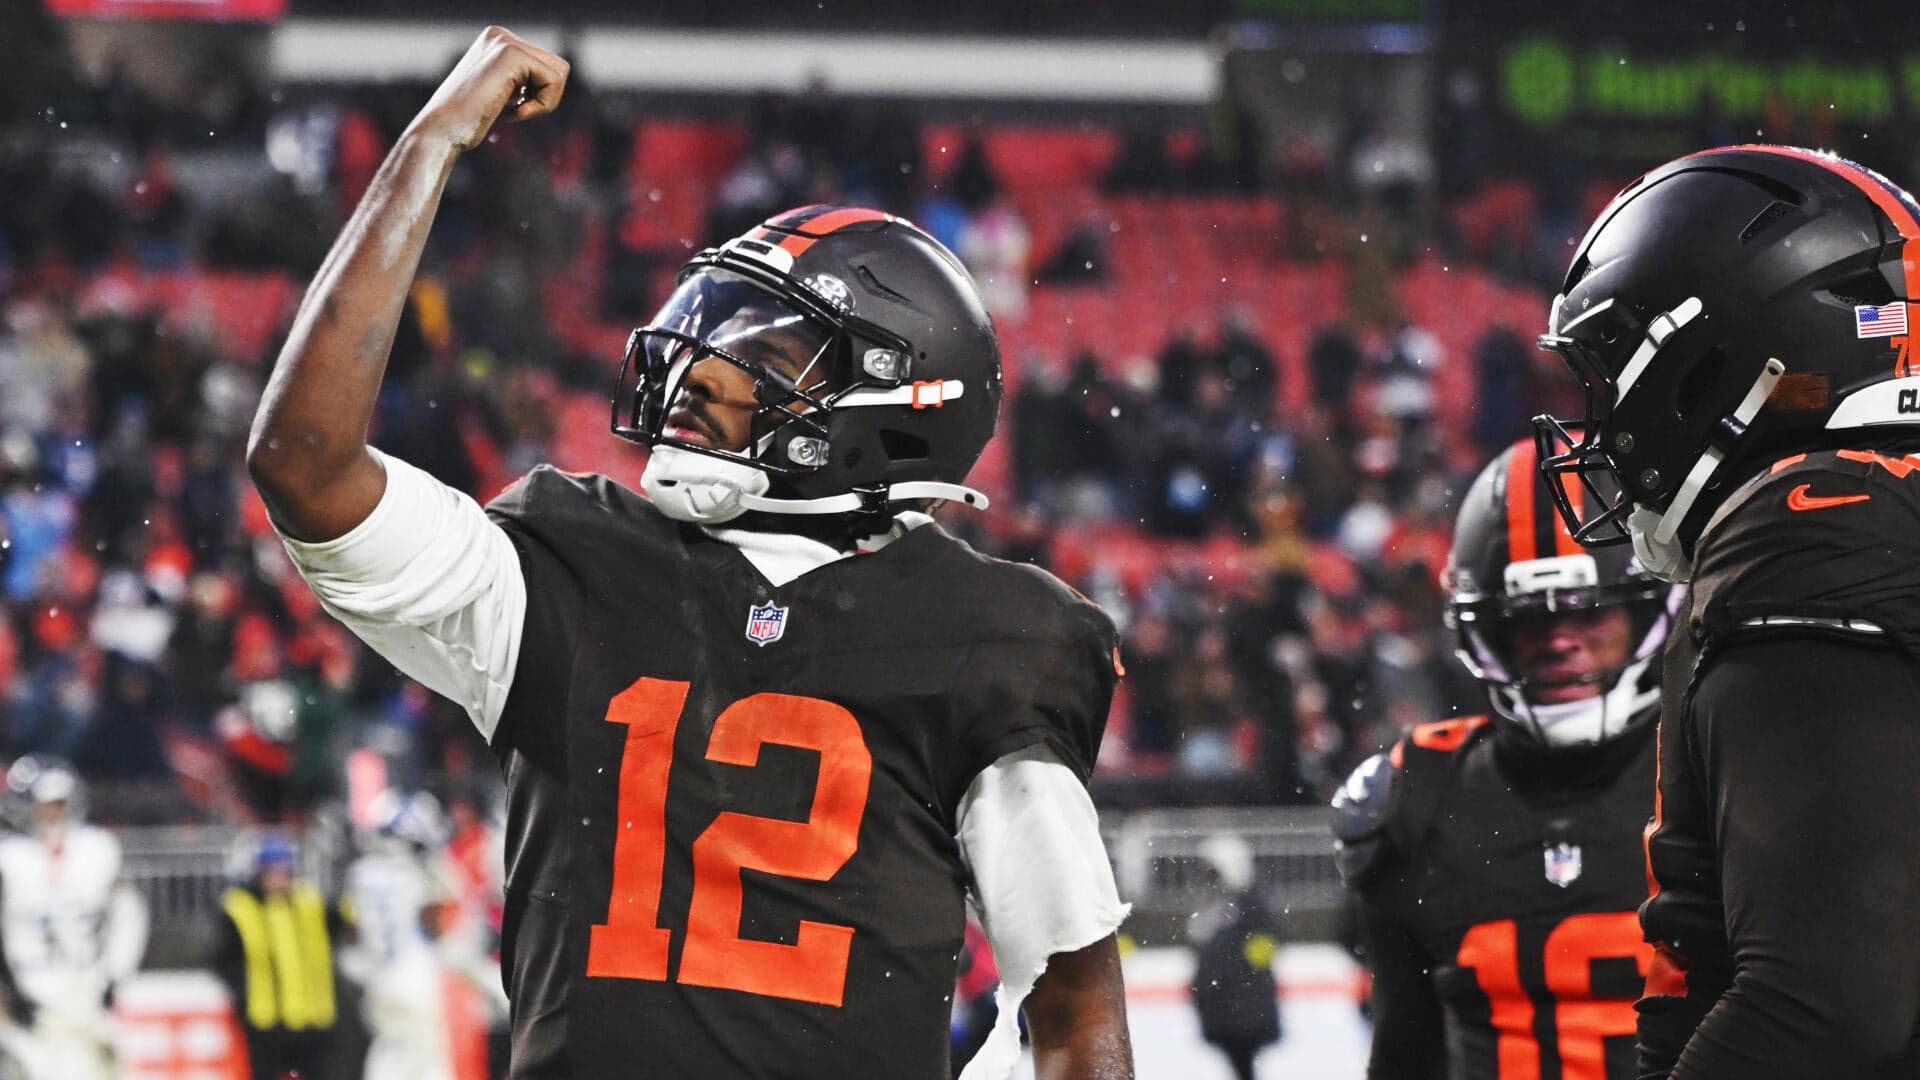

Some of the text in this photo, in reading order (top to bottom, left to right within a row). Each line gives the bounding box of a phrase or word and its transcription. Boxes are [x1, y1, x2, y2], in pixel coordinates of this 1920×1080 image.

[1890, 336, 1909, 378] 7
[752, 621, 777, 638] NFL
[586, 677, 872, 1007] 12
